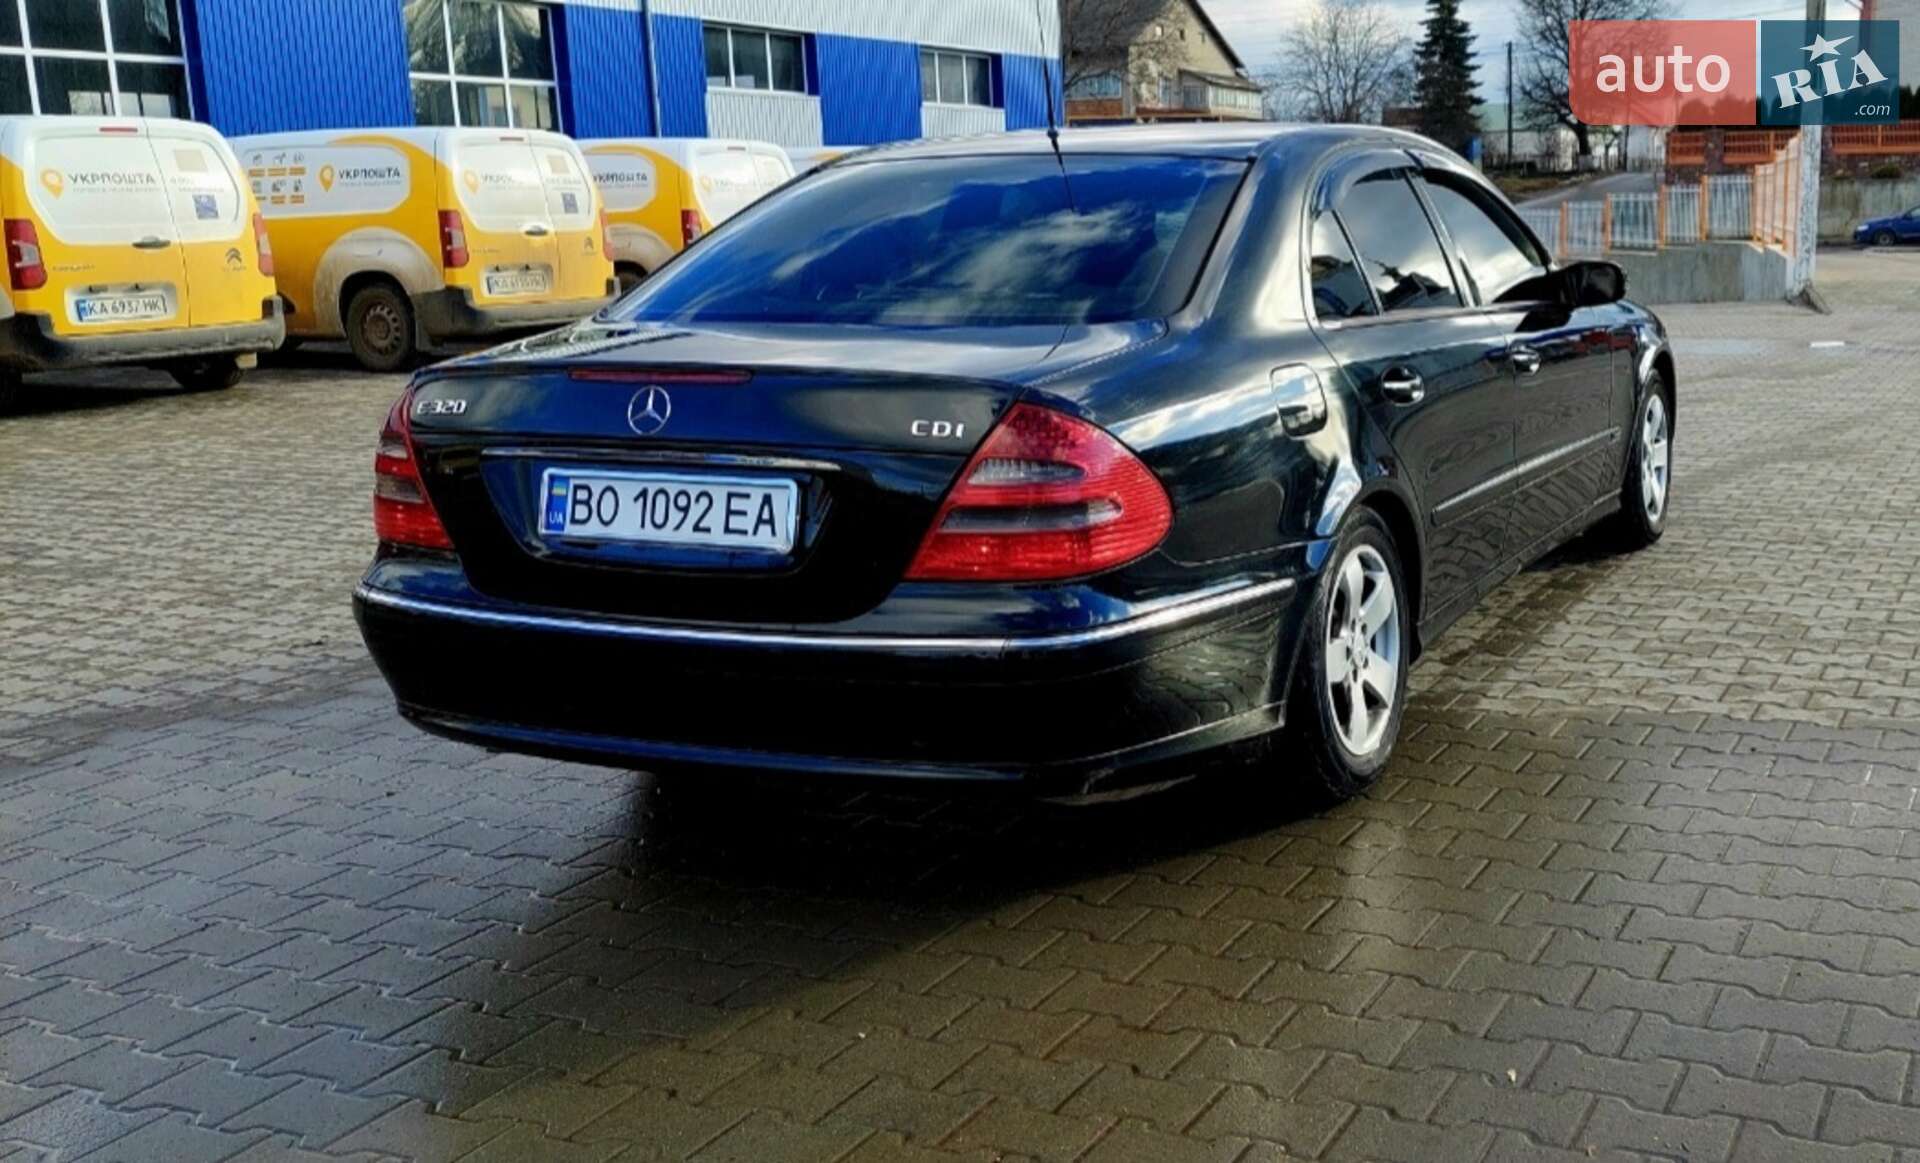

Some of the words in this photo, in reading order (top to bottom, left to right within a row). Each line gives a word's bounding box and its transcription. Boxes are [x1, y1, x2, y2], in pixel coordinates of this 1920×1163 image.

[68, 173, 156, 185] УКРПОШТА
[339, 167, 401, 180] УКРПОШТА
[431, 399, 468, 415] 320
[911, 419, 965, 438] CDI
[569, 484, 620, 527] BO
[633, 487, 714, 533] 1092
[723, 491, 777, 537] EA
